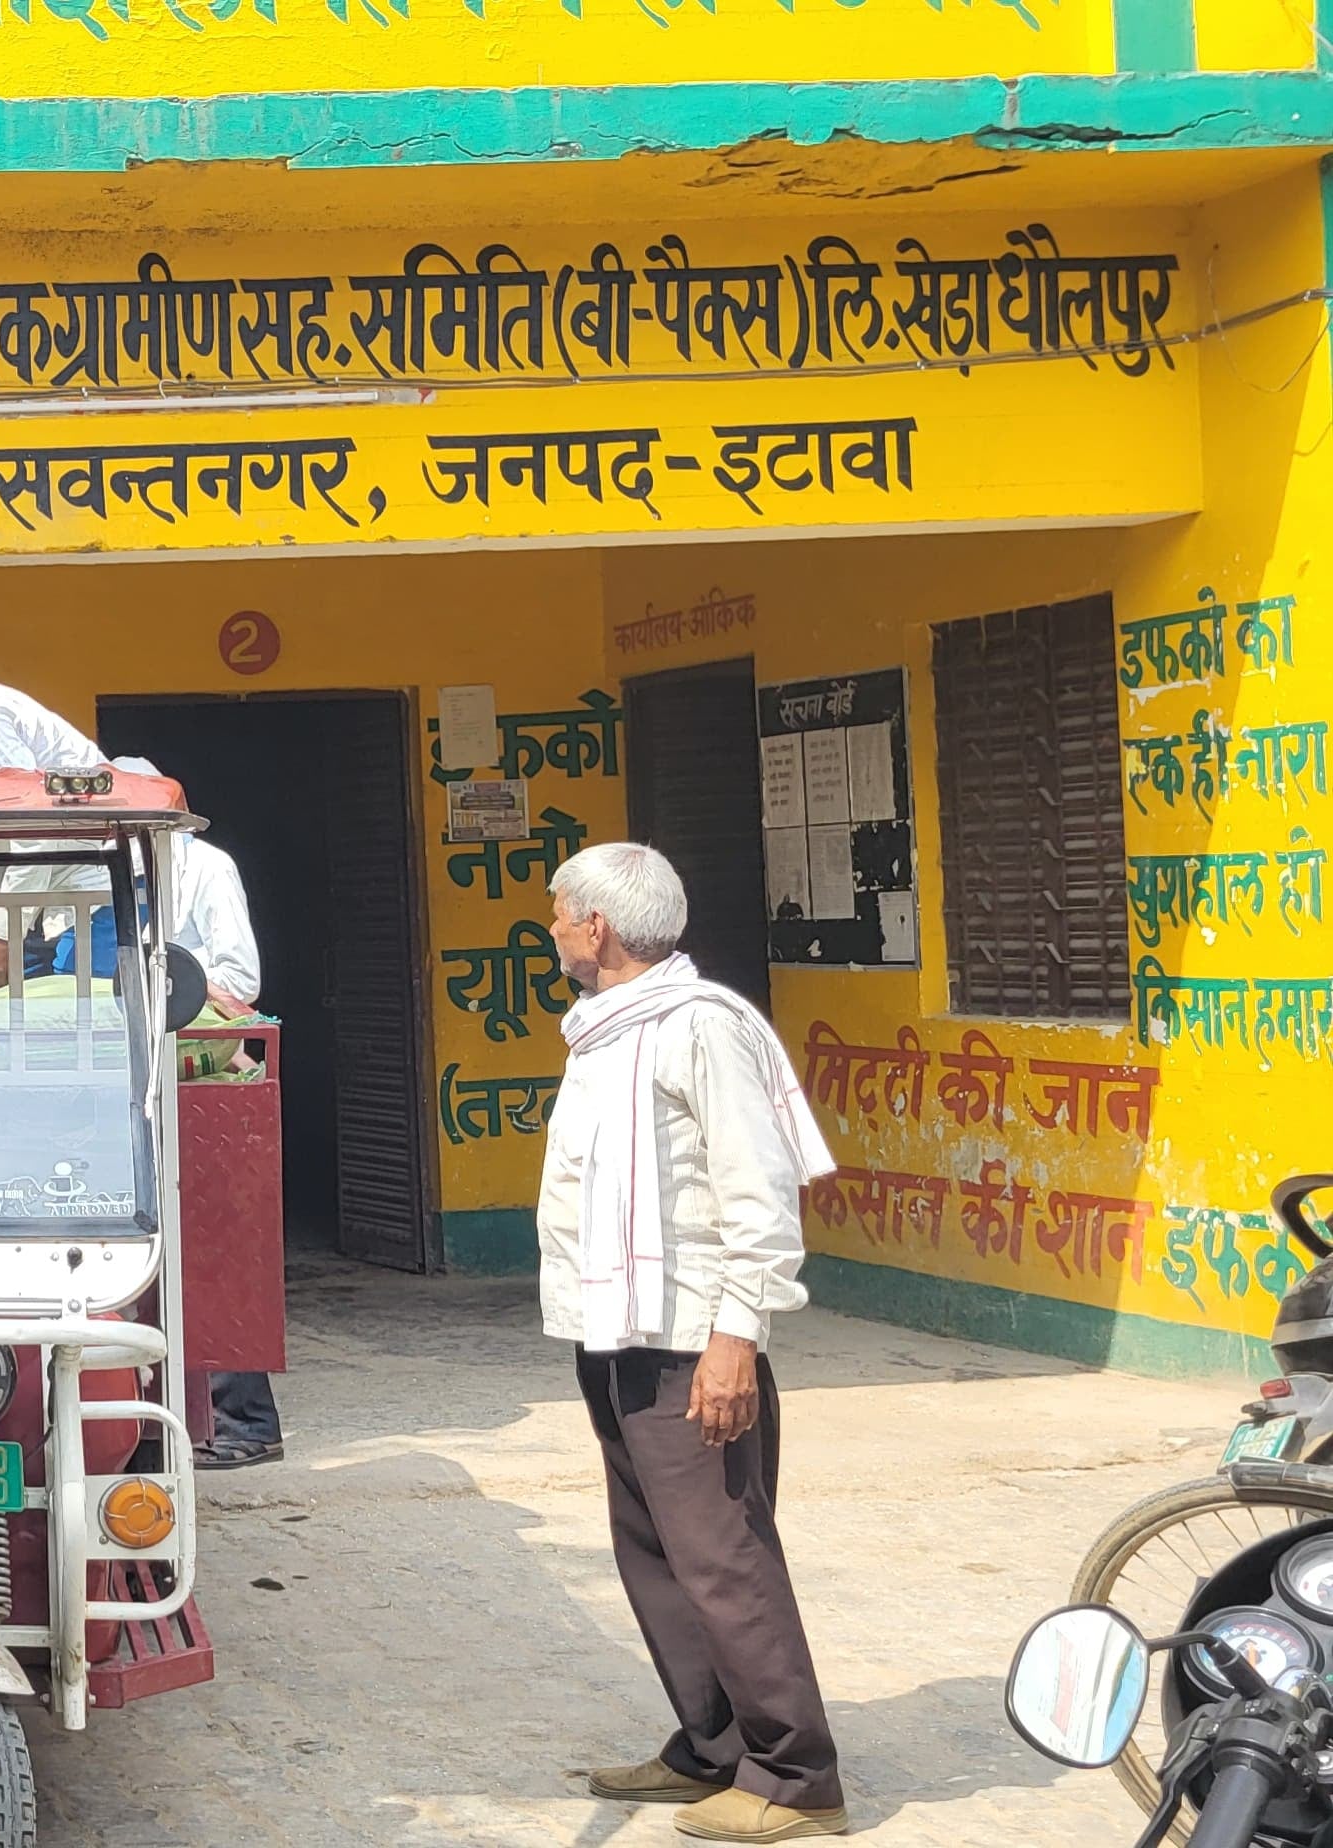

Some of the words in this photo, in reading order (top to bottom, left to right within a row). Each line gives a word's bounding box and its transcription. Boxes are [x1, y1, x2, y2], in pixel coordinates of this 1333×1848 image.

[48, 252, 233, 386] ग्रामीण
[229, 620, 262, 663] 2
[1120, 586, 1228, 689] इफको
[1237, 594, 1296, 667] का
[779, 693, 824, 728] सूचना
[804, 1020, 929, 1130] मिट्टी
[938, 1030, 1014, 1132] की
[1022, 1059, 1161, 1144] जान
[50, 1203, 132, 1216] APPROVED
[959, 1158, 1036, 1264] की
[1036, 1191, 1155, 1284] शान
